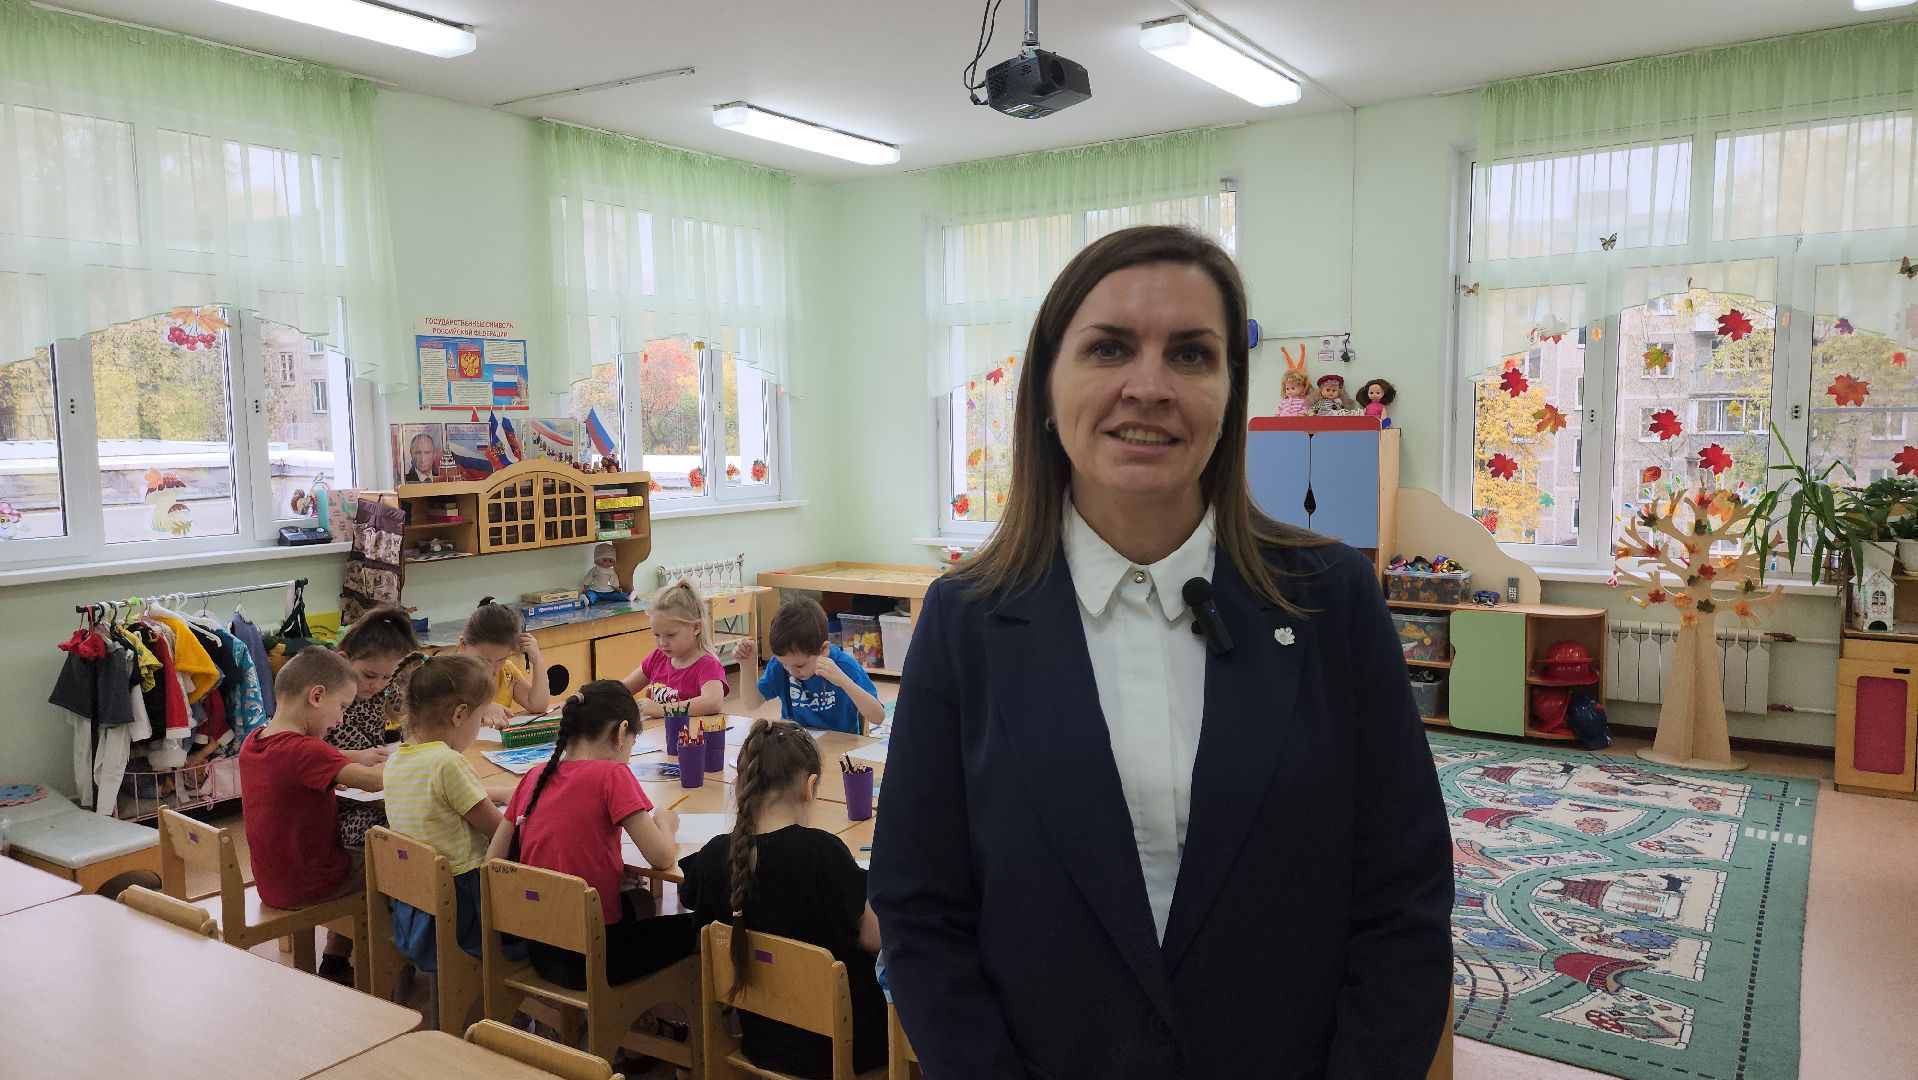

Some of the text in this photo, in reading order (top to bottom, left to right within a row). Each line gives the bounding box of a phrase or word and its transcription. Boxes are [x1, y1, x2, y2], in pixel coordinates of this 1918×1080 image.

[425, 317, 486, 327] ГОСУДАРСТВЕННЫЕ
[432, 327, 508, 338] РОССИЙСКОЙ ФЕДЕРАЦИИ
